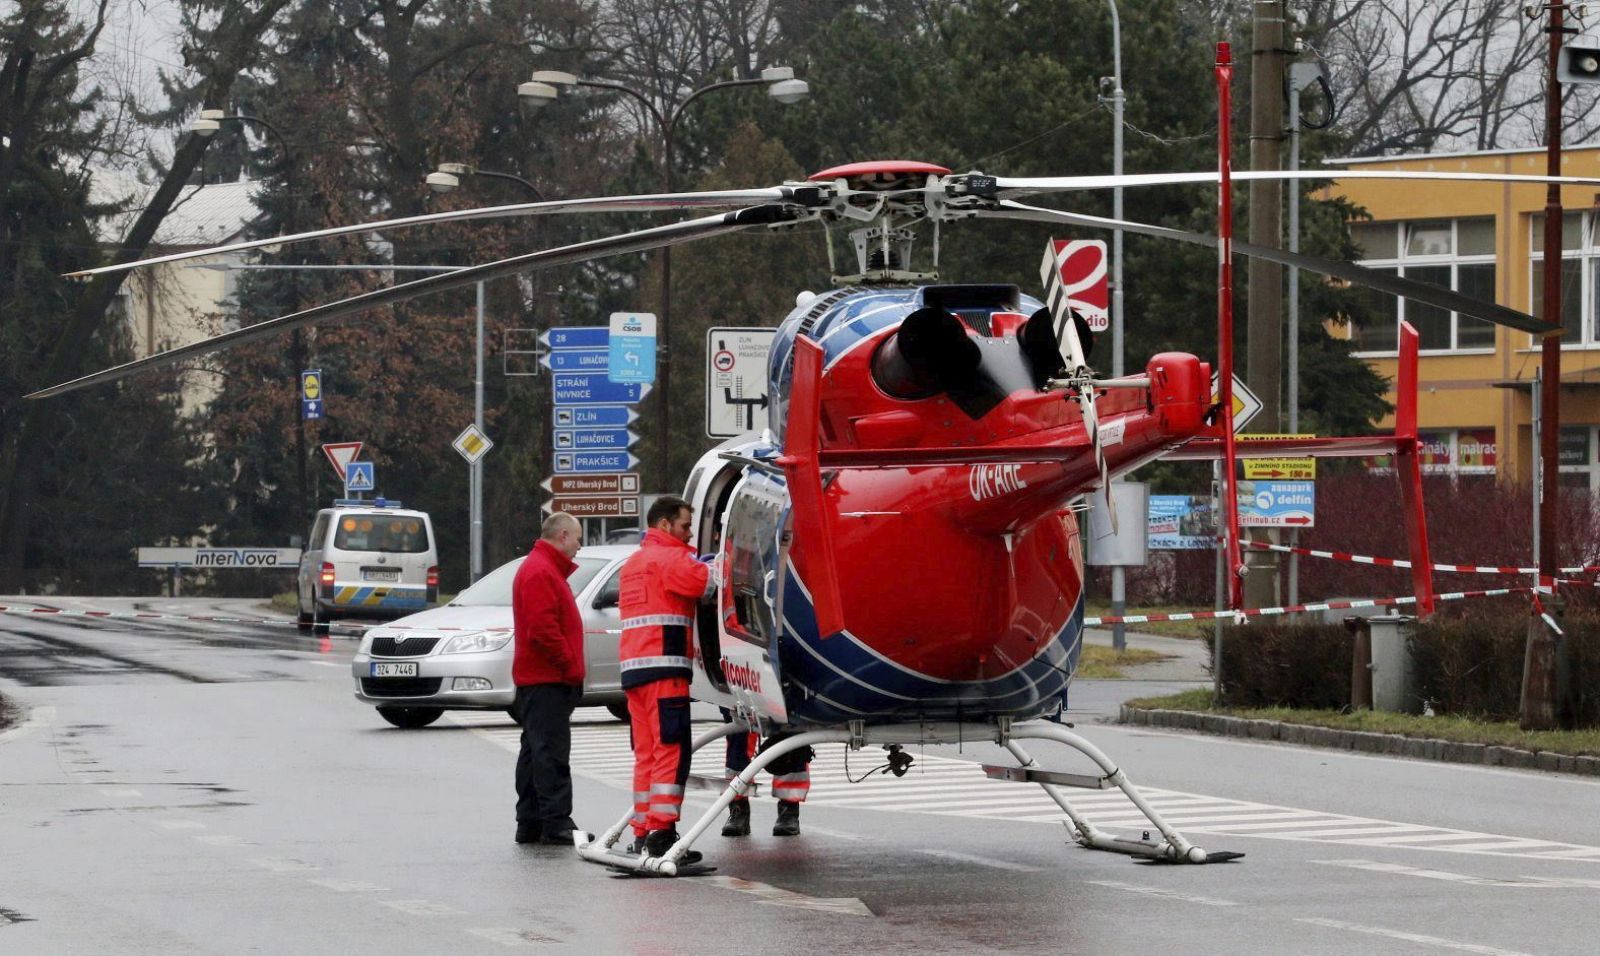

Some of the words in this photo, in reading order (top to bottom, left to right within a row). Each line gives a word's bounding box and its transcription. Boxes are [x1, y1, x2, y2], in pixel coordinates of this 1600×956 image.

[556, 334, 567, 342] 28
[556, 357, 565, 365] 13
[556, 377, 588, 388] STRÁNÍ
[556, 390, 591, 399] NIVNICE
[628, 389, 635, 397] 5
[576, 412, 597, 421] ZLÍN
[576, 432, 615, 444] LUHAČOVICE
[576, 456, 619, 466] PRAKŠICE
[576, 481, 602, 490] Uherský
[602, 480, 617, 488] Brod
[1271, 484, 1312, 492] aquapark
[561, 503, 597, 513] Uherský
[597, 502, 618, 511] Brod
[195, 550, 277, 566] interNova
[377, 664, 390, 675] 3Z4
[393, 664, 413, 675] 7446
